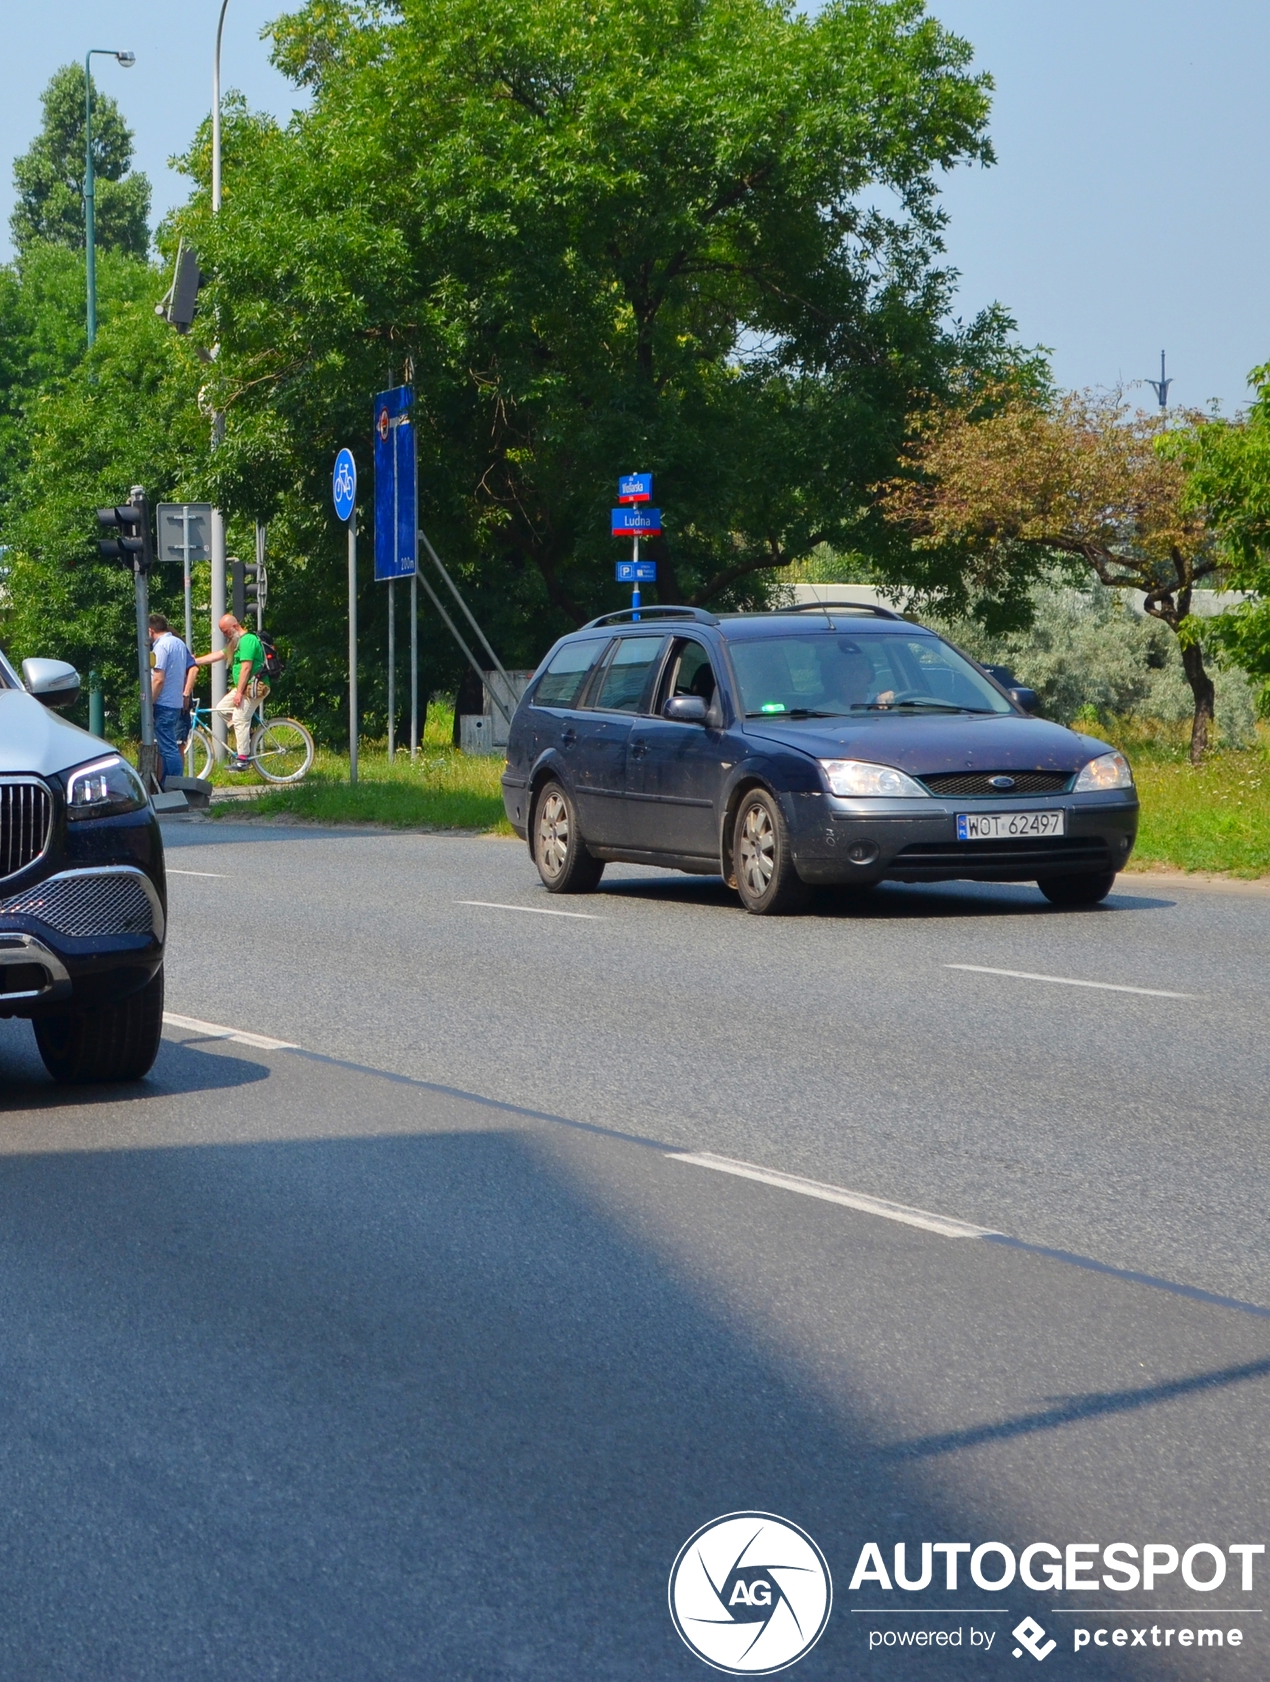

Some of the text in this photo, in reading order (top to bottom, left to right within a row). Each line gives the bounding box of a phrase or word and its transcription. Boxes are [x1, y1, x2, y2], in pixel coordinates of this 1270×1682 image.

[624, 515, 651, 526] Ludna
[968, 814, 1060, 837] WOT 62497
